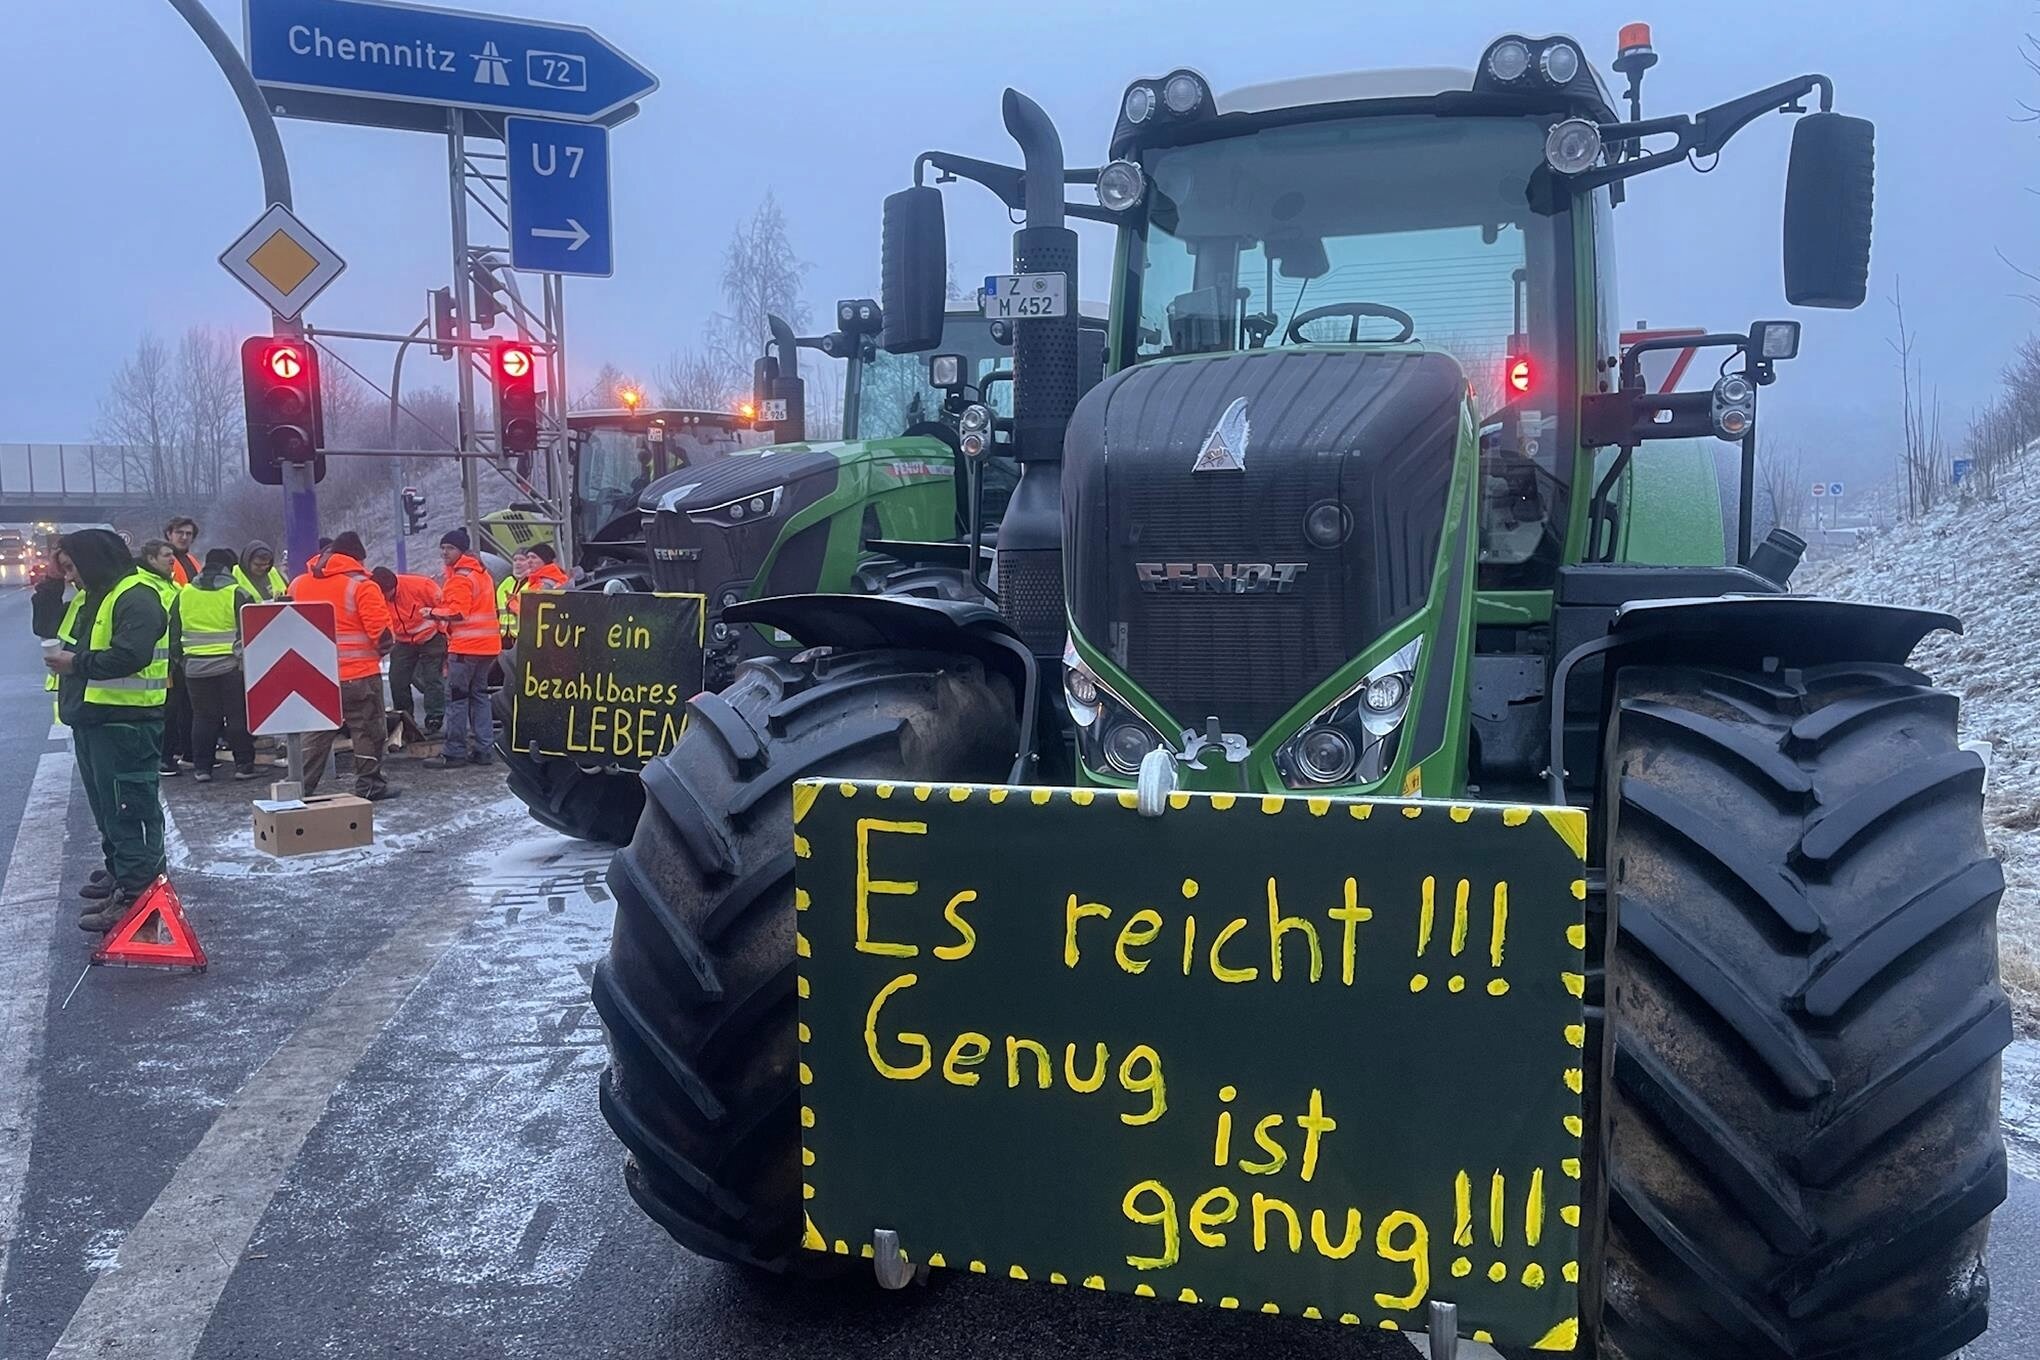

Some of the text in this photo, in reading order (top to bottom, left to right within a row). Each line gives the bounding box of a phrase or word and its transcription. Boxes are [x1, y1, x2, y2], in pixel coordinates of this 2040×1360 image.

[288, 24, 570, 83] Chemnitz 72
[532, 142, 584, 178] U 7
[999, 296, 1053, 317] M 452
[1009, 278, 1021, 296] Z
[1135, 562, 1309, 594] FENDT
[536, 602, 651, 649] Für ein
[524, 661, 679, 706] bezahlbares
[566, 705, 689, 758] LEBEN
[856, 818, 978, 960] Es
[1063, 876, 1373, 987] reicht
[864, 973, 1170, 1126] Genug
[1214, 1085, 1337, 1182] ist
